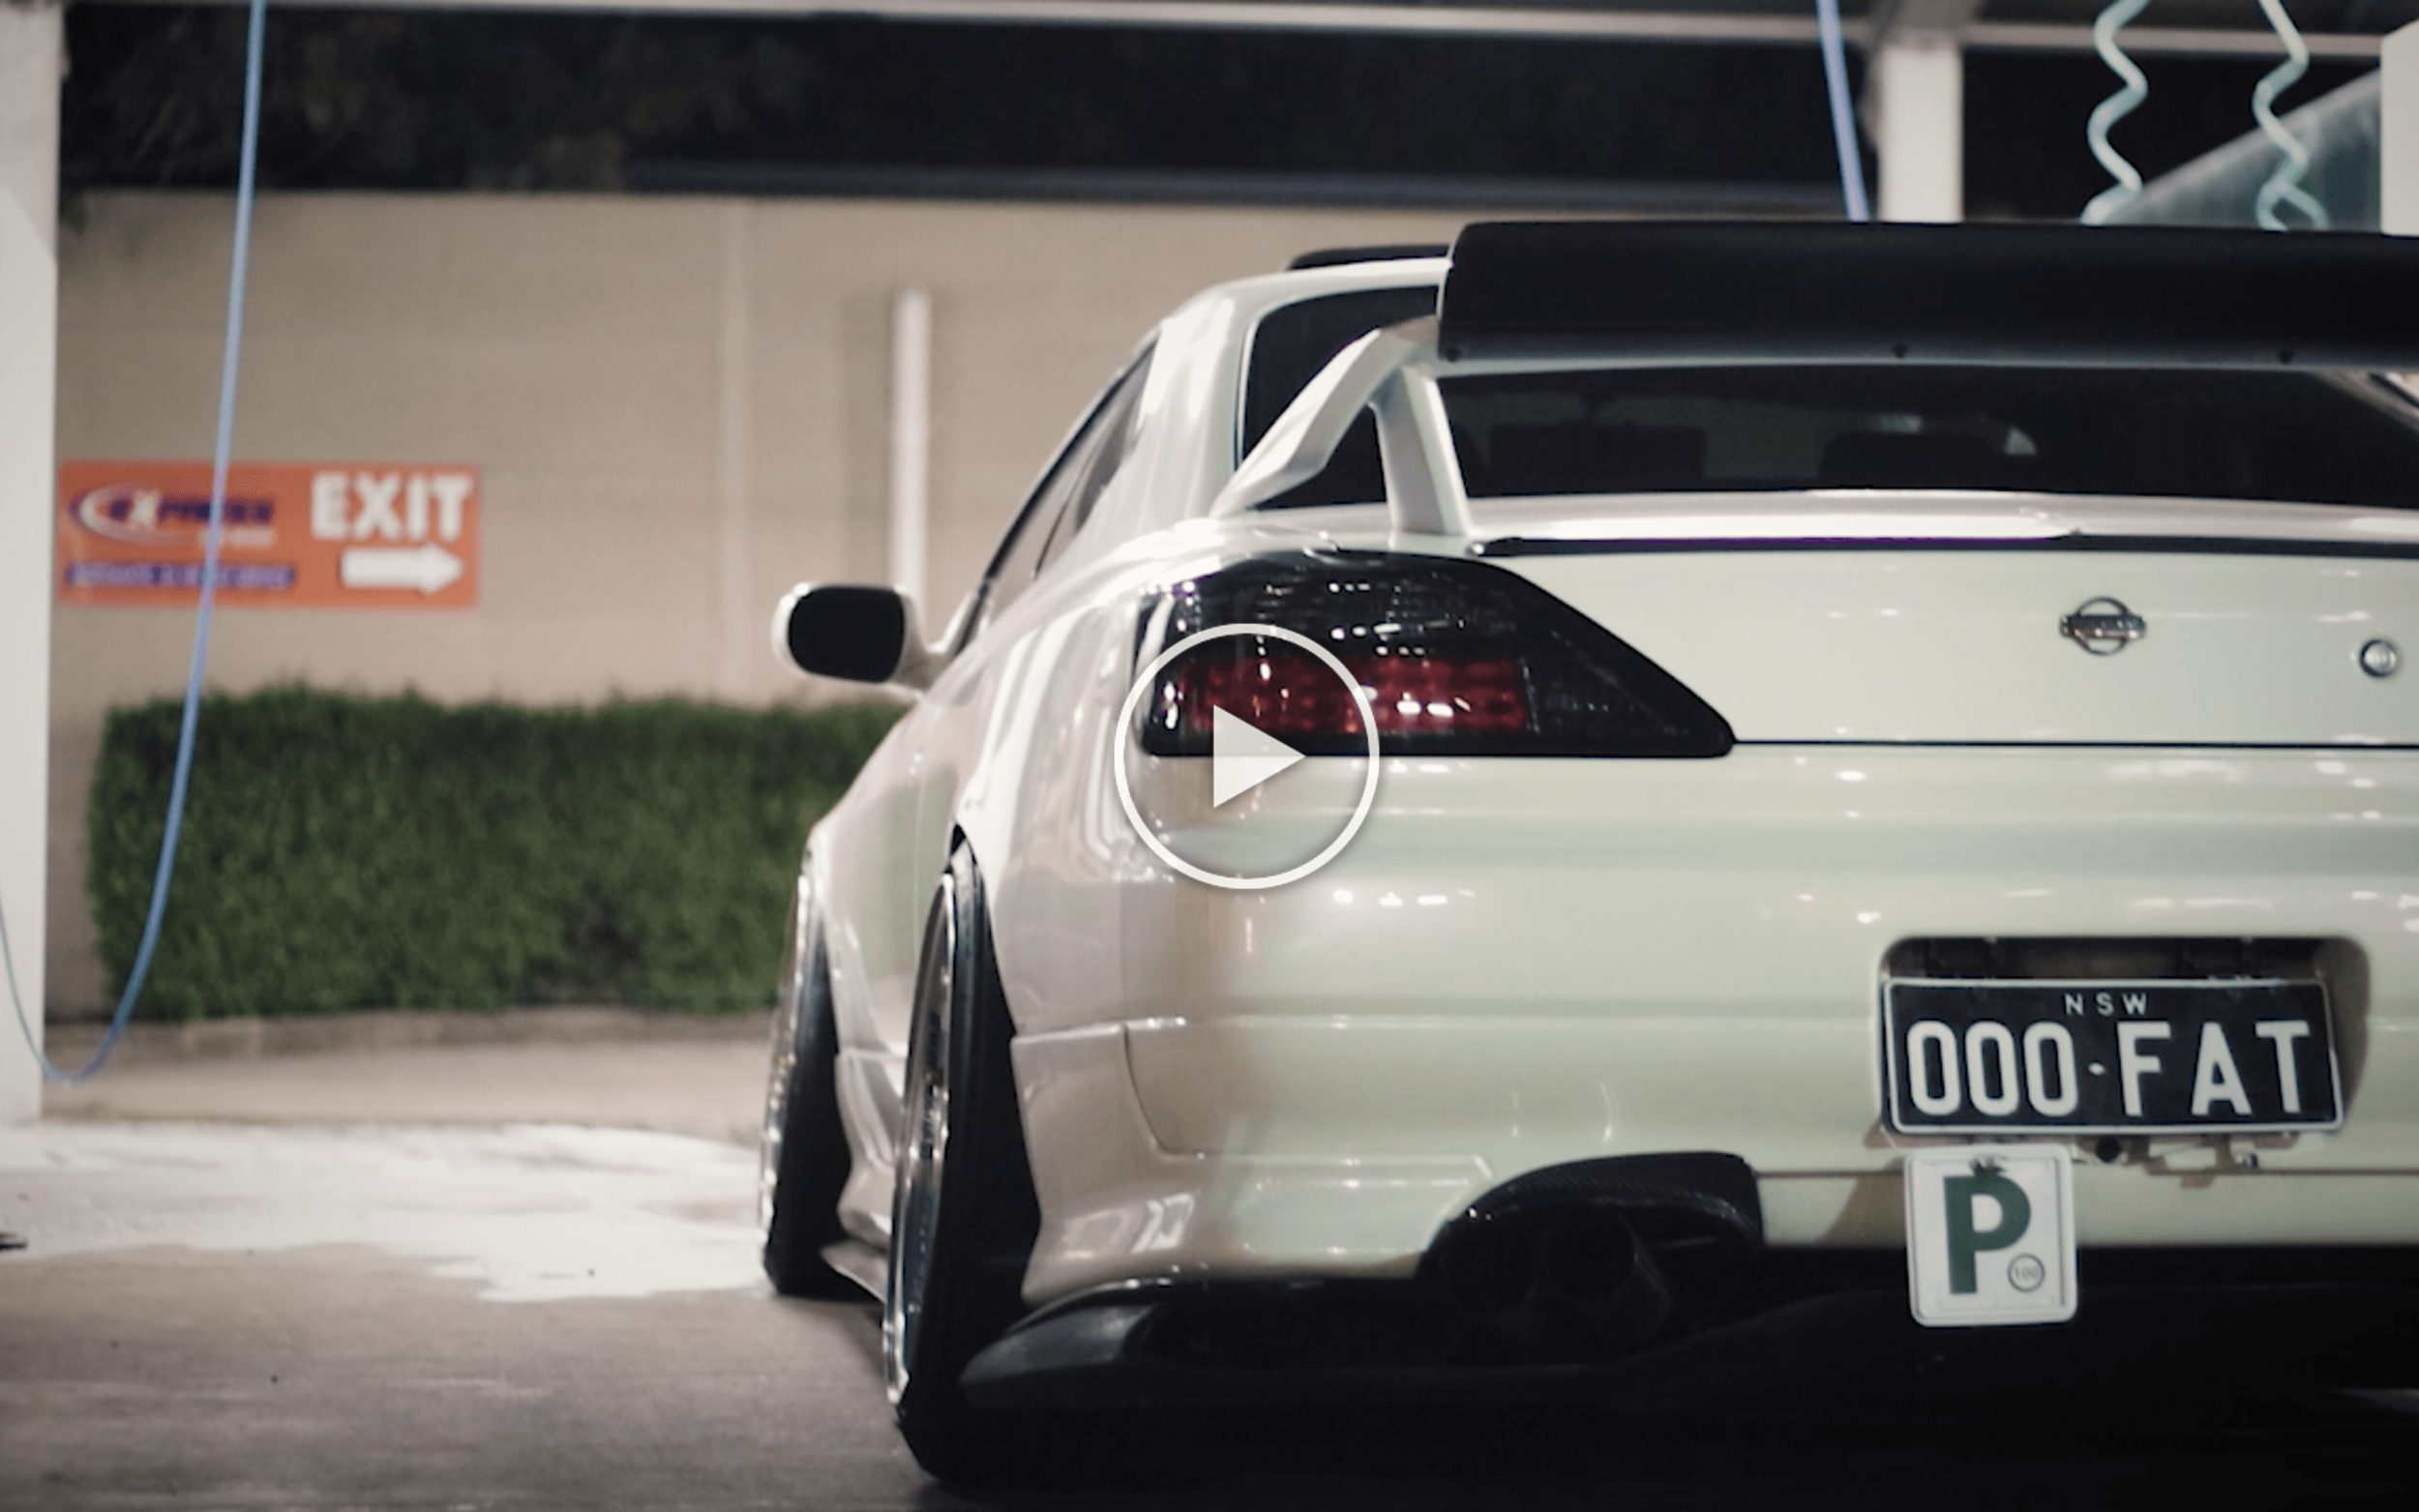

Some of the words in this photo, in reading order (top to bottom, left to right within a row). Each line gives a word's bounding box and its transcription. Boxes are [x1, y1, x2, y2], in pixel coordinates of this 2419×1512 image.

[310, 471, 474, 541] EXIT
[2063, 993, 2150, 1016] NSW
[1943, 1174, 2031, 1294] P
